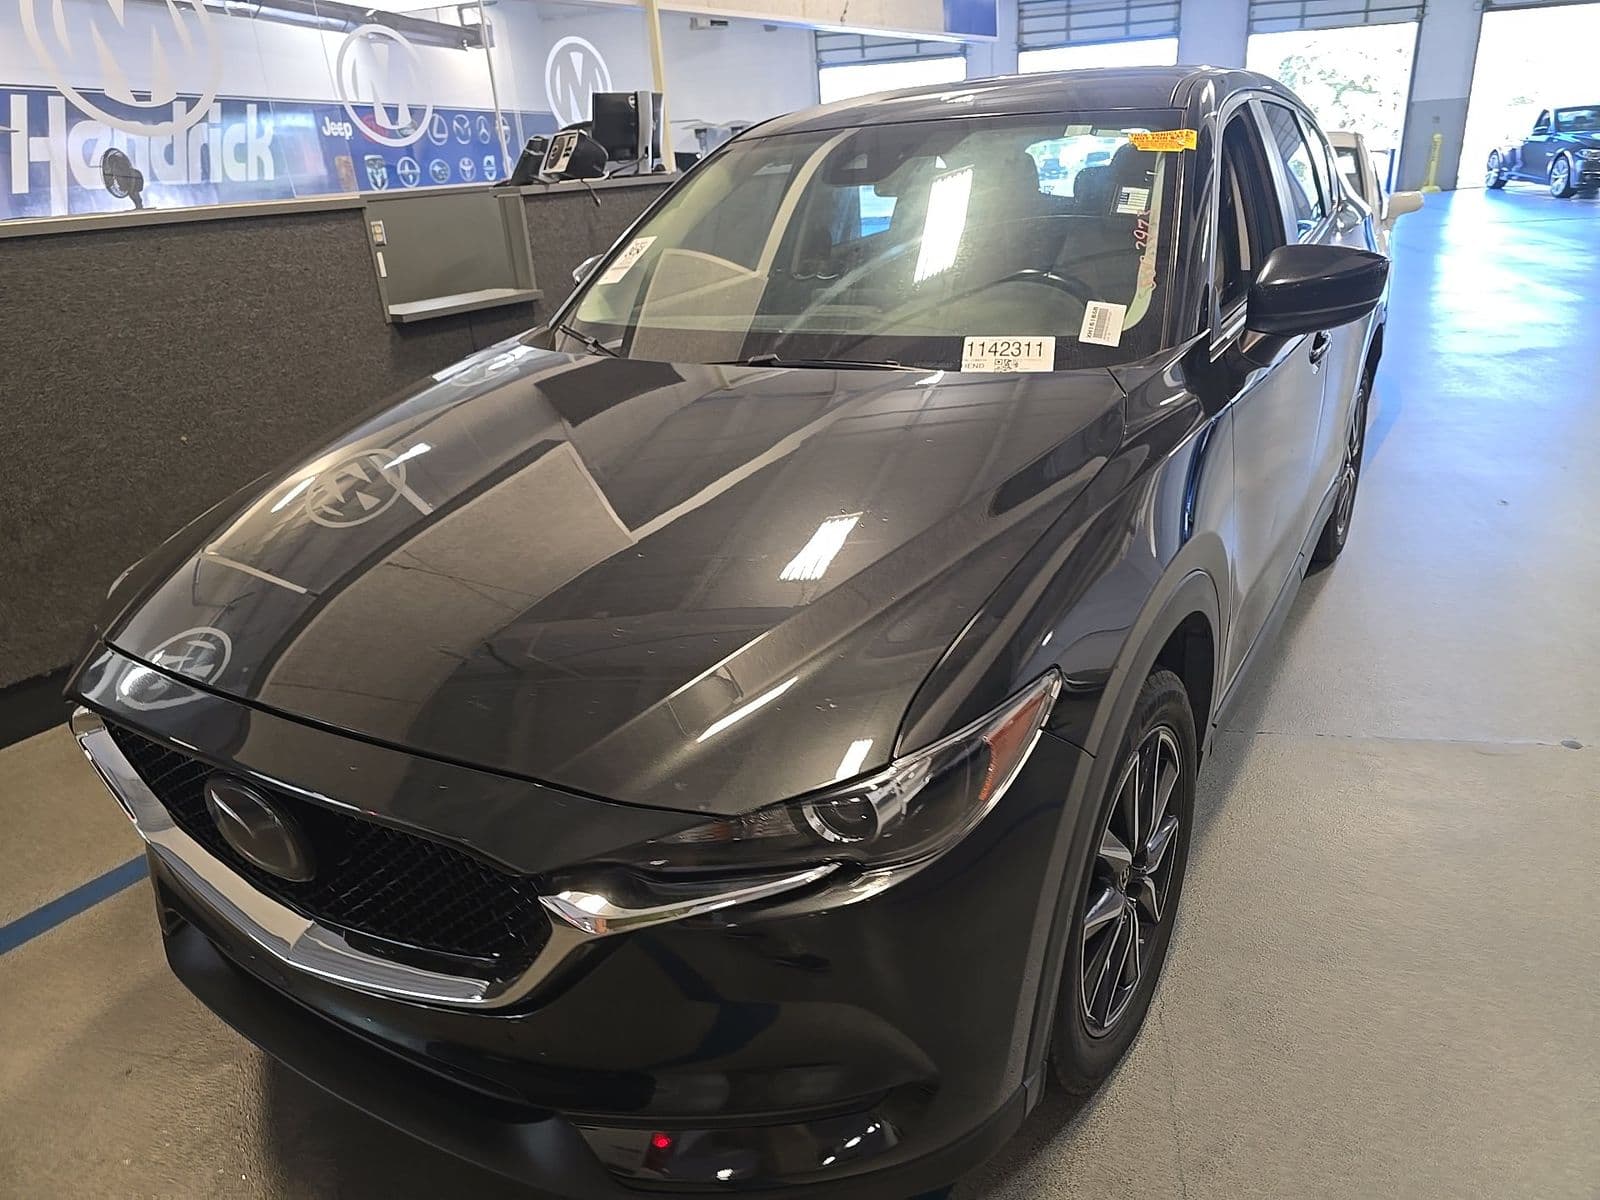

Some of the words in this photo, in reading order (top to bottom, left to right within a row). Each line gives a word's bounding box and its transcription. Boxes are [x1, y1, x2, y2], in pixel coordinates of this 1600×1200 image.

[322, 116, 352, 140] Jeep
[10, 94, 275, 216] Hendrick
[967, 341, 1043, 357] 1142311
